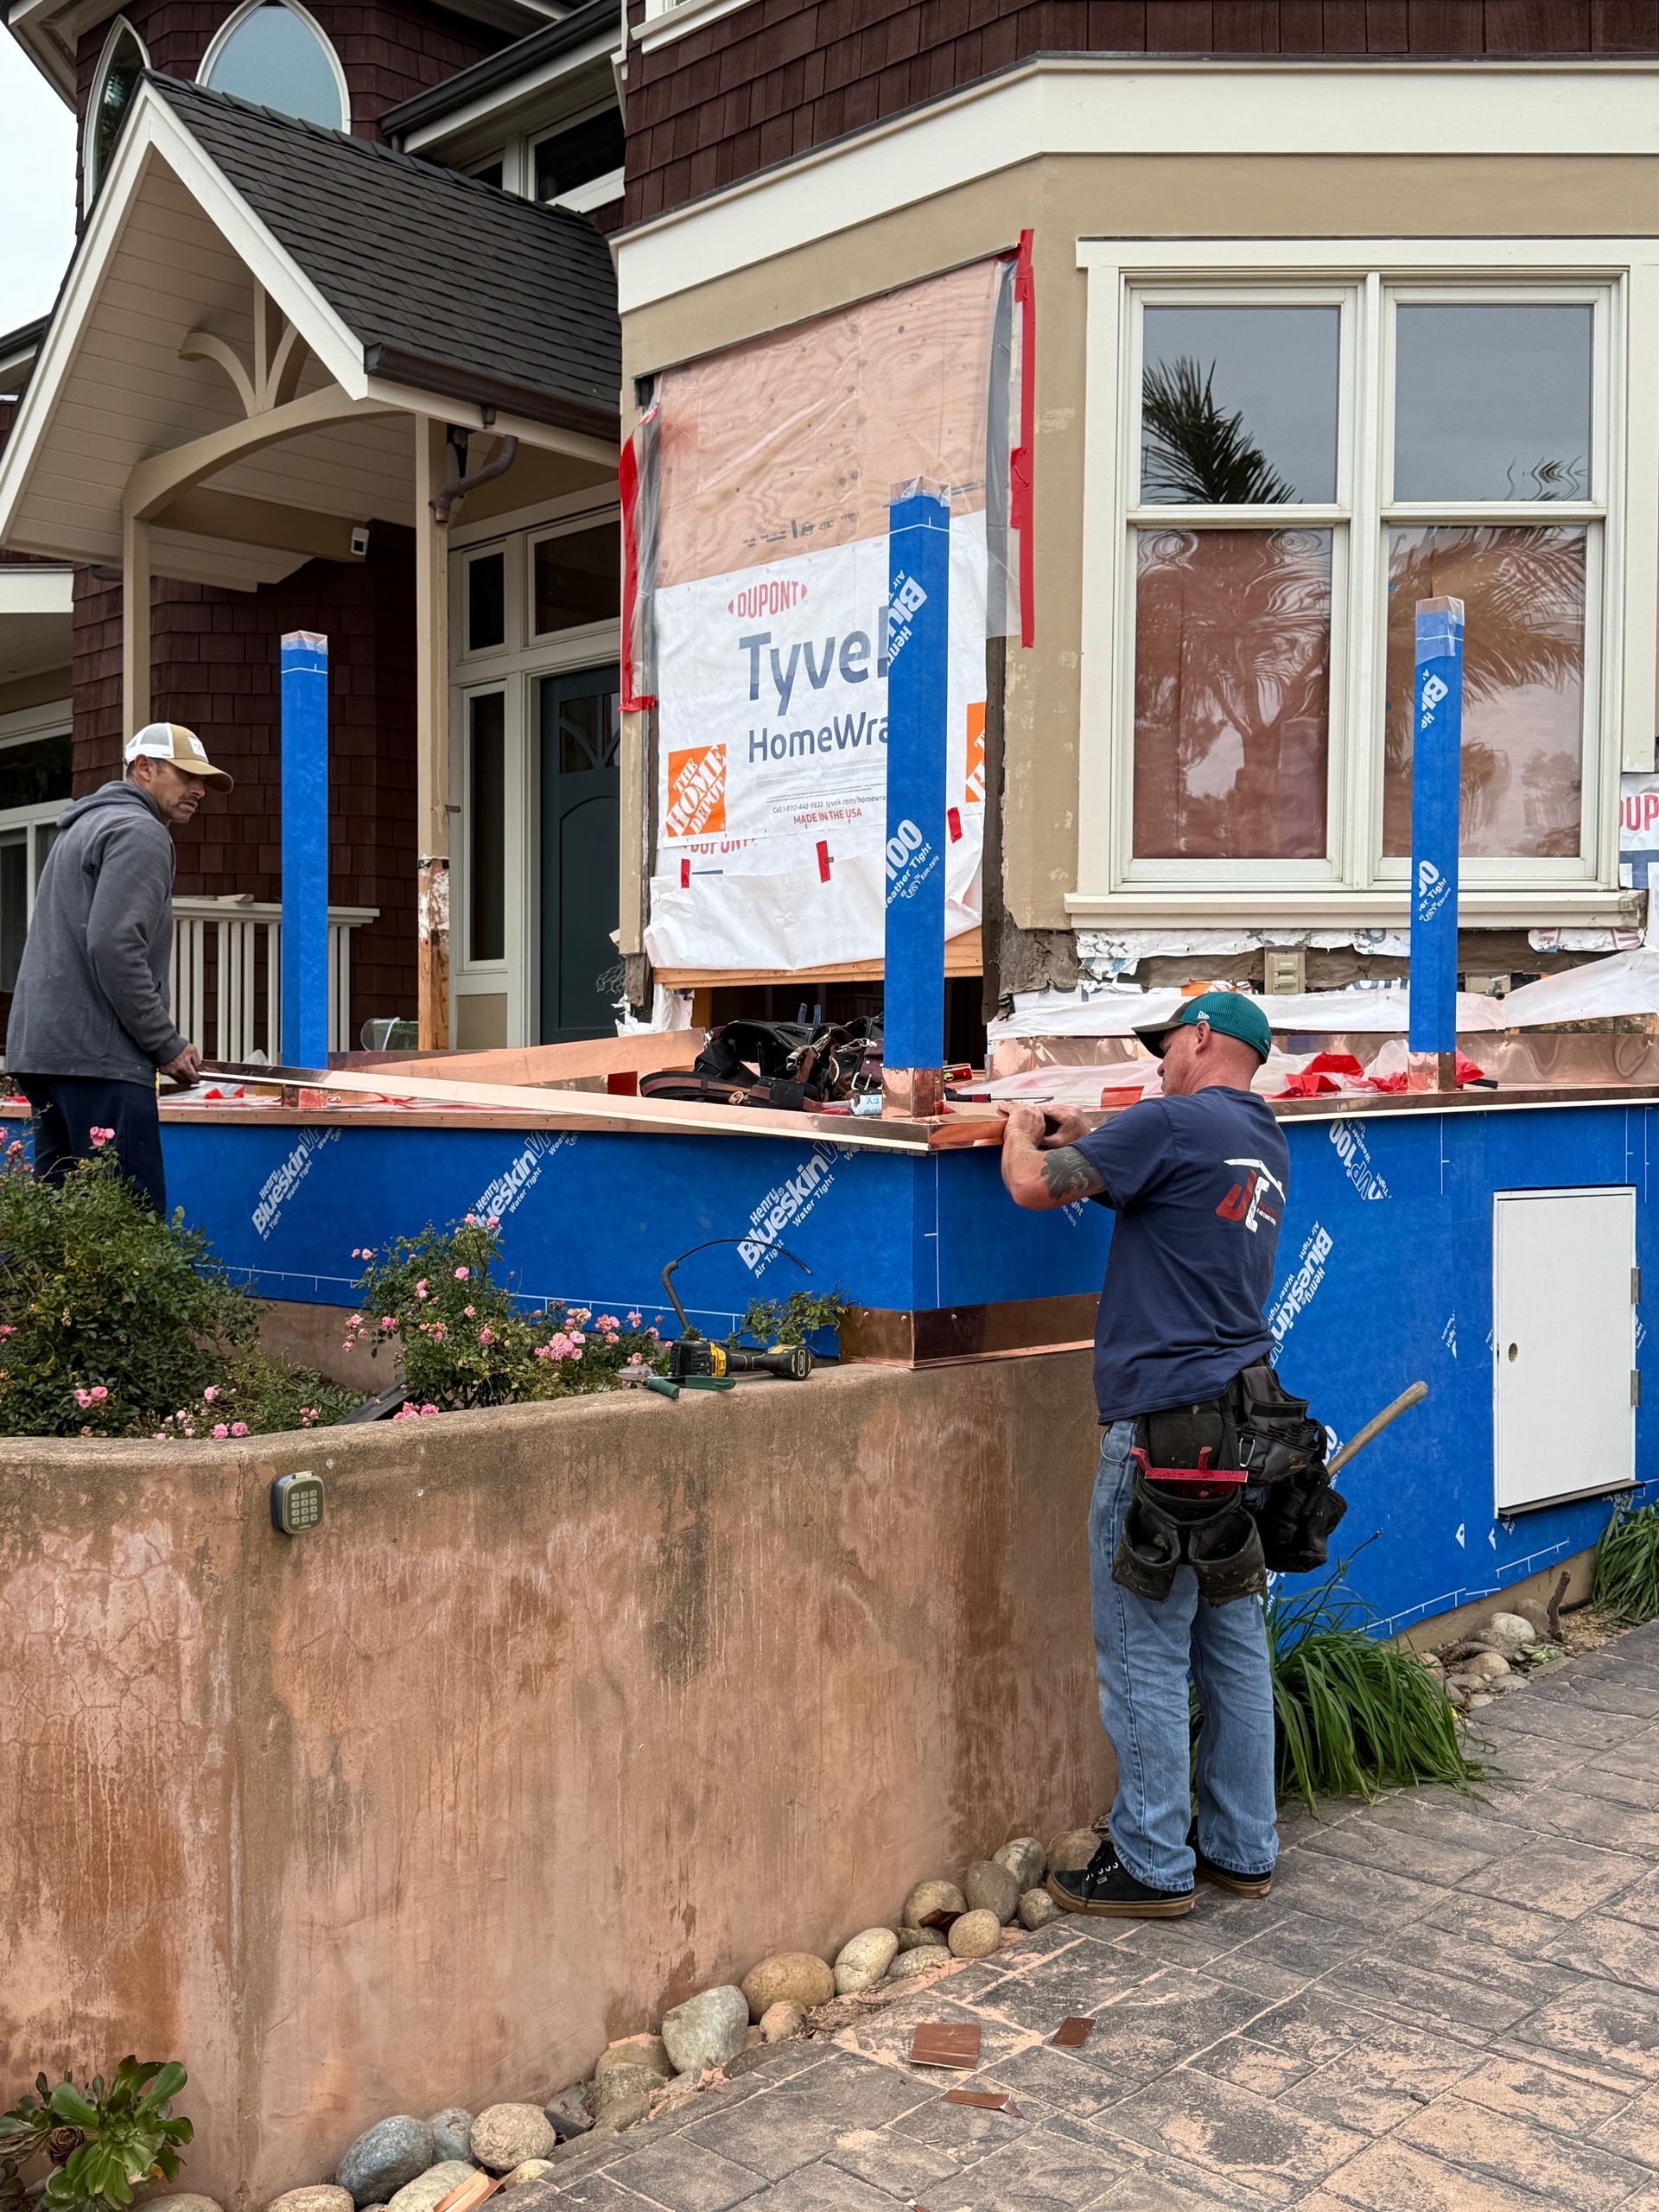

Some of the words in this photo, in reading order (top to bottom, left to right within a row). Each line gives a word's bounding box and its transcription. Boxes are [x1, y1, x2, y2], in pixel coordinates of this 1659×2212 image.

[736, 580, 799, 619] DUPONT
[665, 744, 727, 836] HOME
[672, 756, 699, 794] THE
[690, 777, 727, 835] DEPOT
[793, 812, 817, 825] MADE
[818, 810, 829, 822] IN
[829, 810, 844, 821] THE
[846, 808, 862, 820] USA
[909, 842, 932, 869] Tight
[251, 1144, 309, 1235] Blueskin
[286, 1179, 300, 1201] Water
[299, 1160, 313, 1179] Tight
[509, 1188, 527, 1213] Water
[524, 1166, 543, 1190] Tight
[791, 1198, 815, 1228] Water
[813, 1173, 836, 1199] Tight
[736, 1154, 830, 1271] Blueskin
[1311, 1219, 1320, 1236] Air
[1299, 1236, 1313, 1261] Tight
[754, 1262, 766, 1280] Air
[1270, 1226, 1334, 1341] Blueskin
[1279, 1274, 1295, 1301] Water
